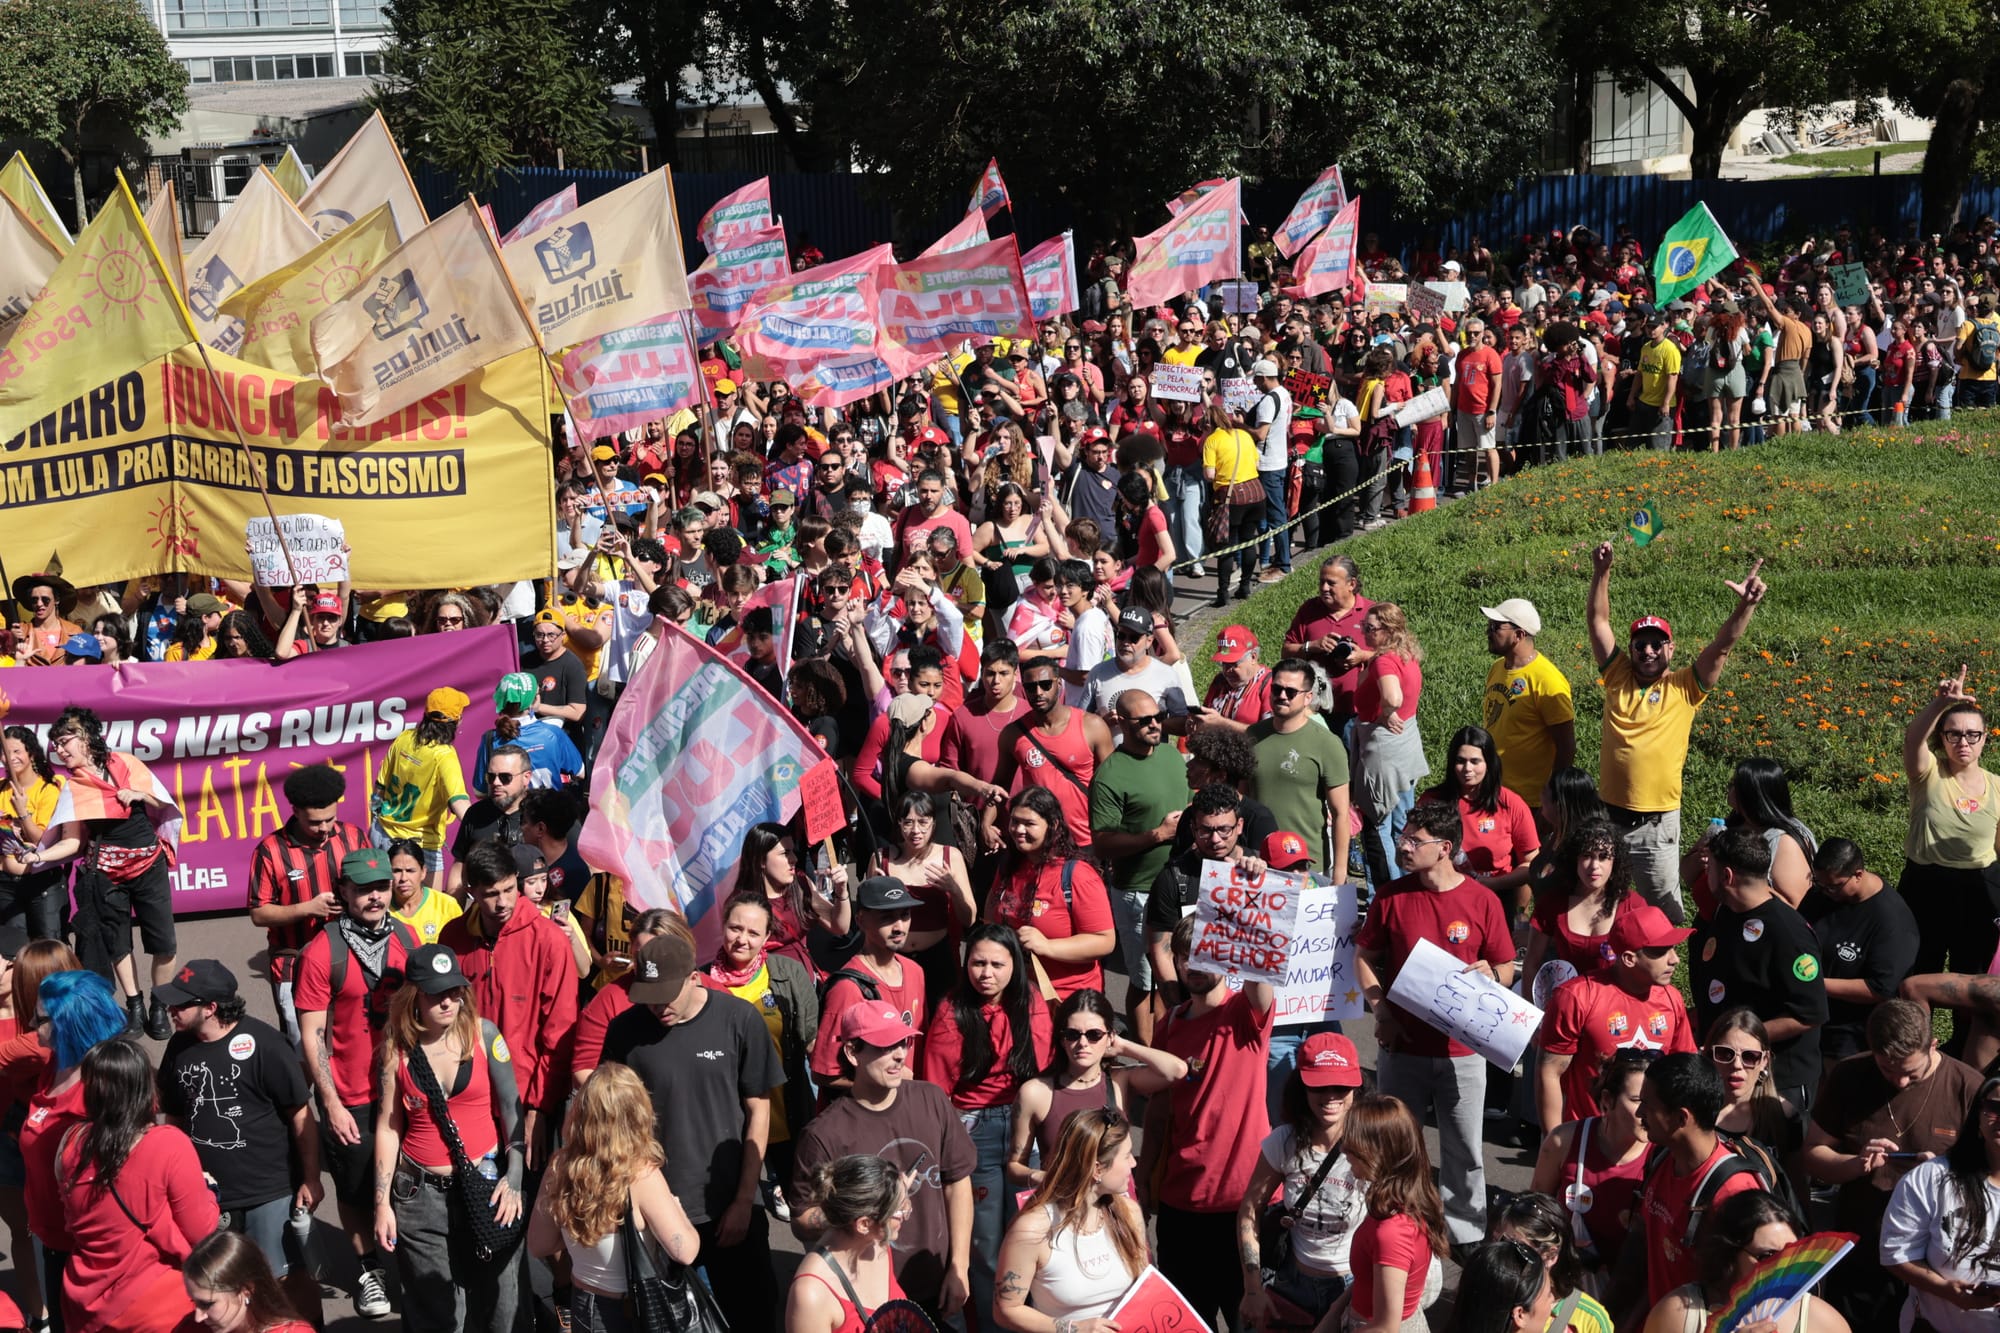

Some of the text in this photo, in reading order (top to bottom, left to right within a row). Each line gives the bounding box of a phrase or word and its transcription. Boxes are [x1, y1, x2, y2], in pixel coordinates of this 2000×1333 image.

[1167, 375, 1184, 384] PELA
[1221, 378, 1252, 388] EDUCAÇ
[161, 362, 298, 440] NUNCA
[43, 454, 110, 499] LULA
[117, 441, 170, 487] PRA
[173, 439, 269, 490] BARRAR
[276, 453, 295, 492] O
[303, 454, 460, 496] FASCISMO
[1122, 610, 1144, 624] LULA
[1637, 616, 1662, 630] LULA
[1217, 636, 1238, 648] LULA
[173, 711, 272, 759] NAS
[279, 696, 417, 750] RUAS.
[1230, 866, 1266, 890] EU
[1304, 902, 1335, 923] SE
[1202, 922, 1289, 951] MUNDO
[1194, 938, 1288, 975] MELHOR
[1285, 961, 1345, 988] MUDAR
